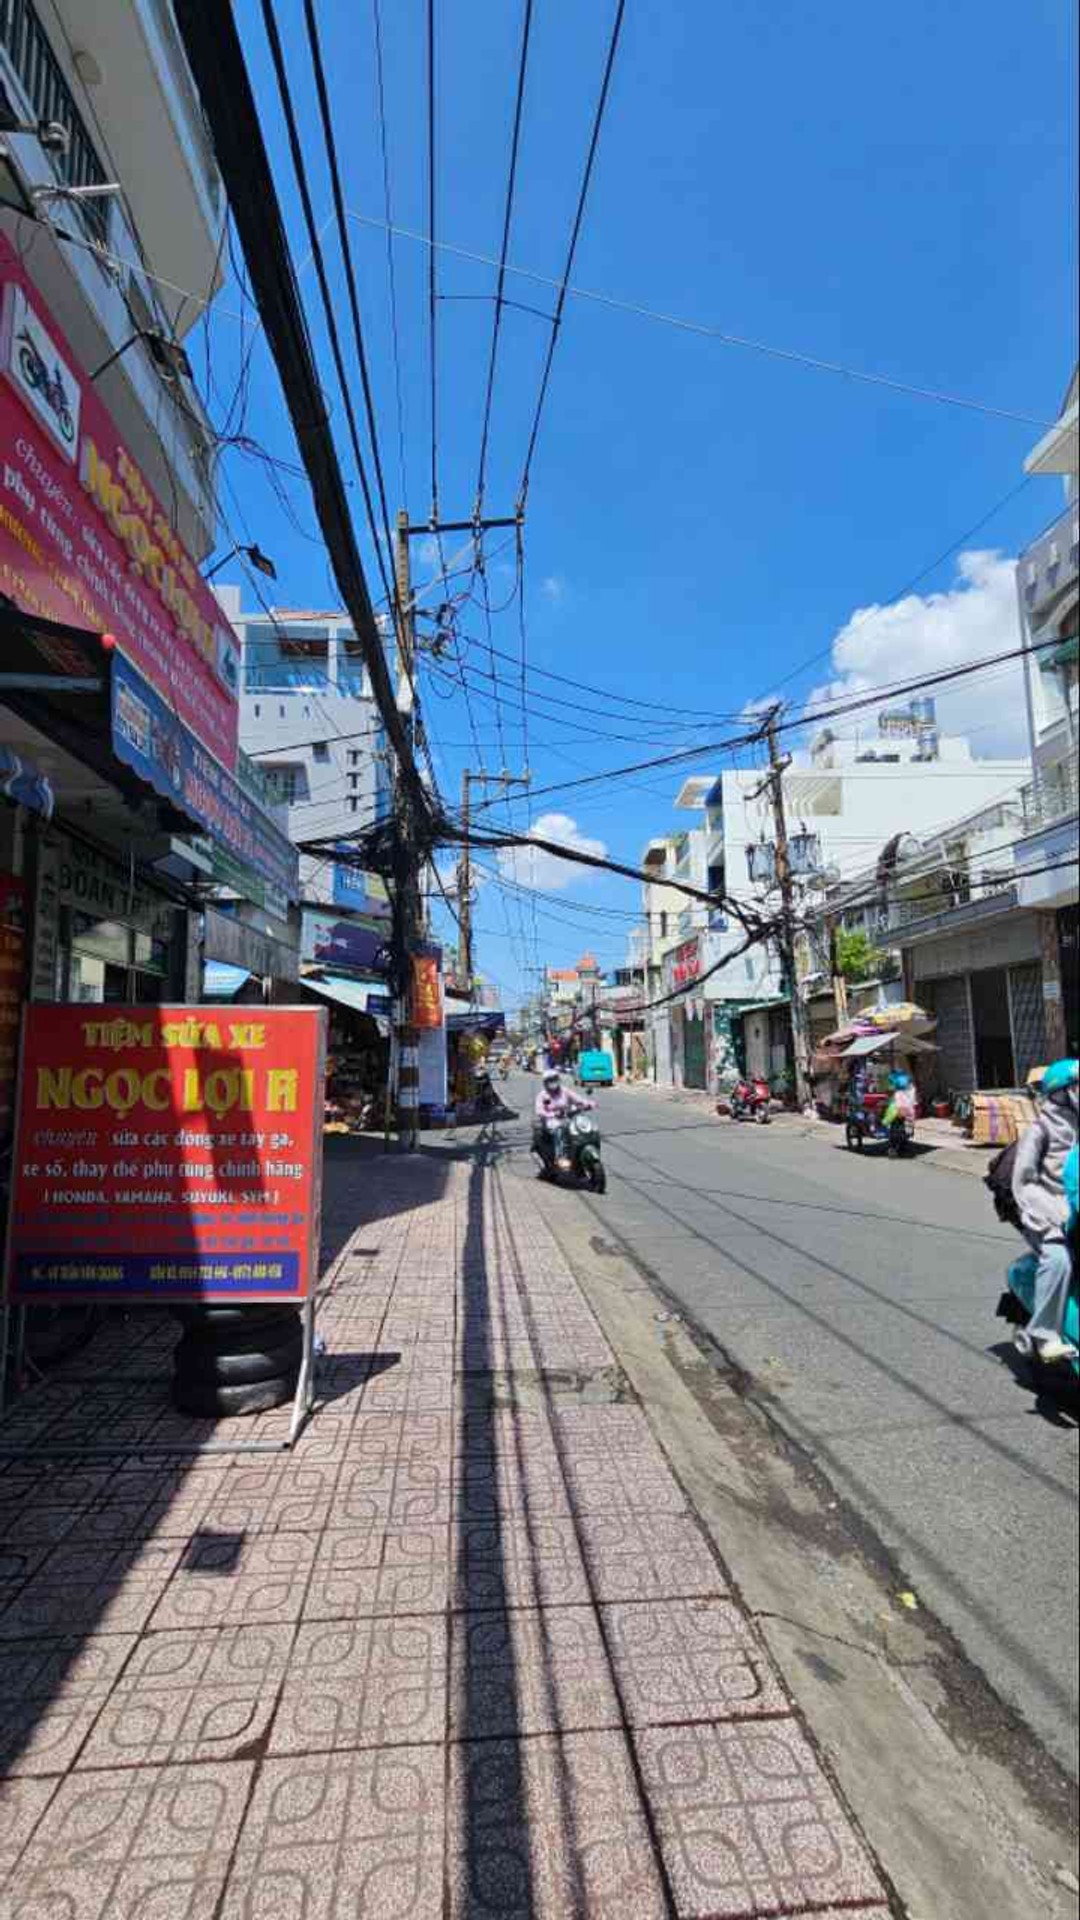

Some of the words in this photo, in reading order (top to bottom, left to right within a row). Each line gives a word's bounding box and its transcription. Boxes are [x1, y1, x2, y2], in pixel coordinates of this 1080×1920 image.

[82, 1017, 152, 1052] TIỆM
[161, 1015, 222, 1050] SỬA
[228, 1022, 266, 1049] XE
[36, 1066, 172, 1120] NGỌC
[182, 1066, 255, 1120] LỢI
[143, 1129, 169, 1147] các
[72, 1158, 107, 1182] thay
